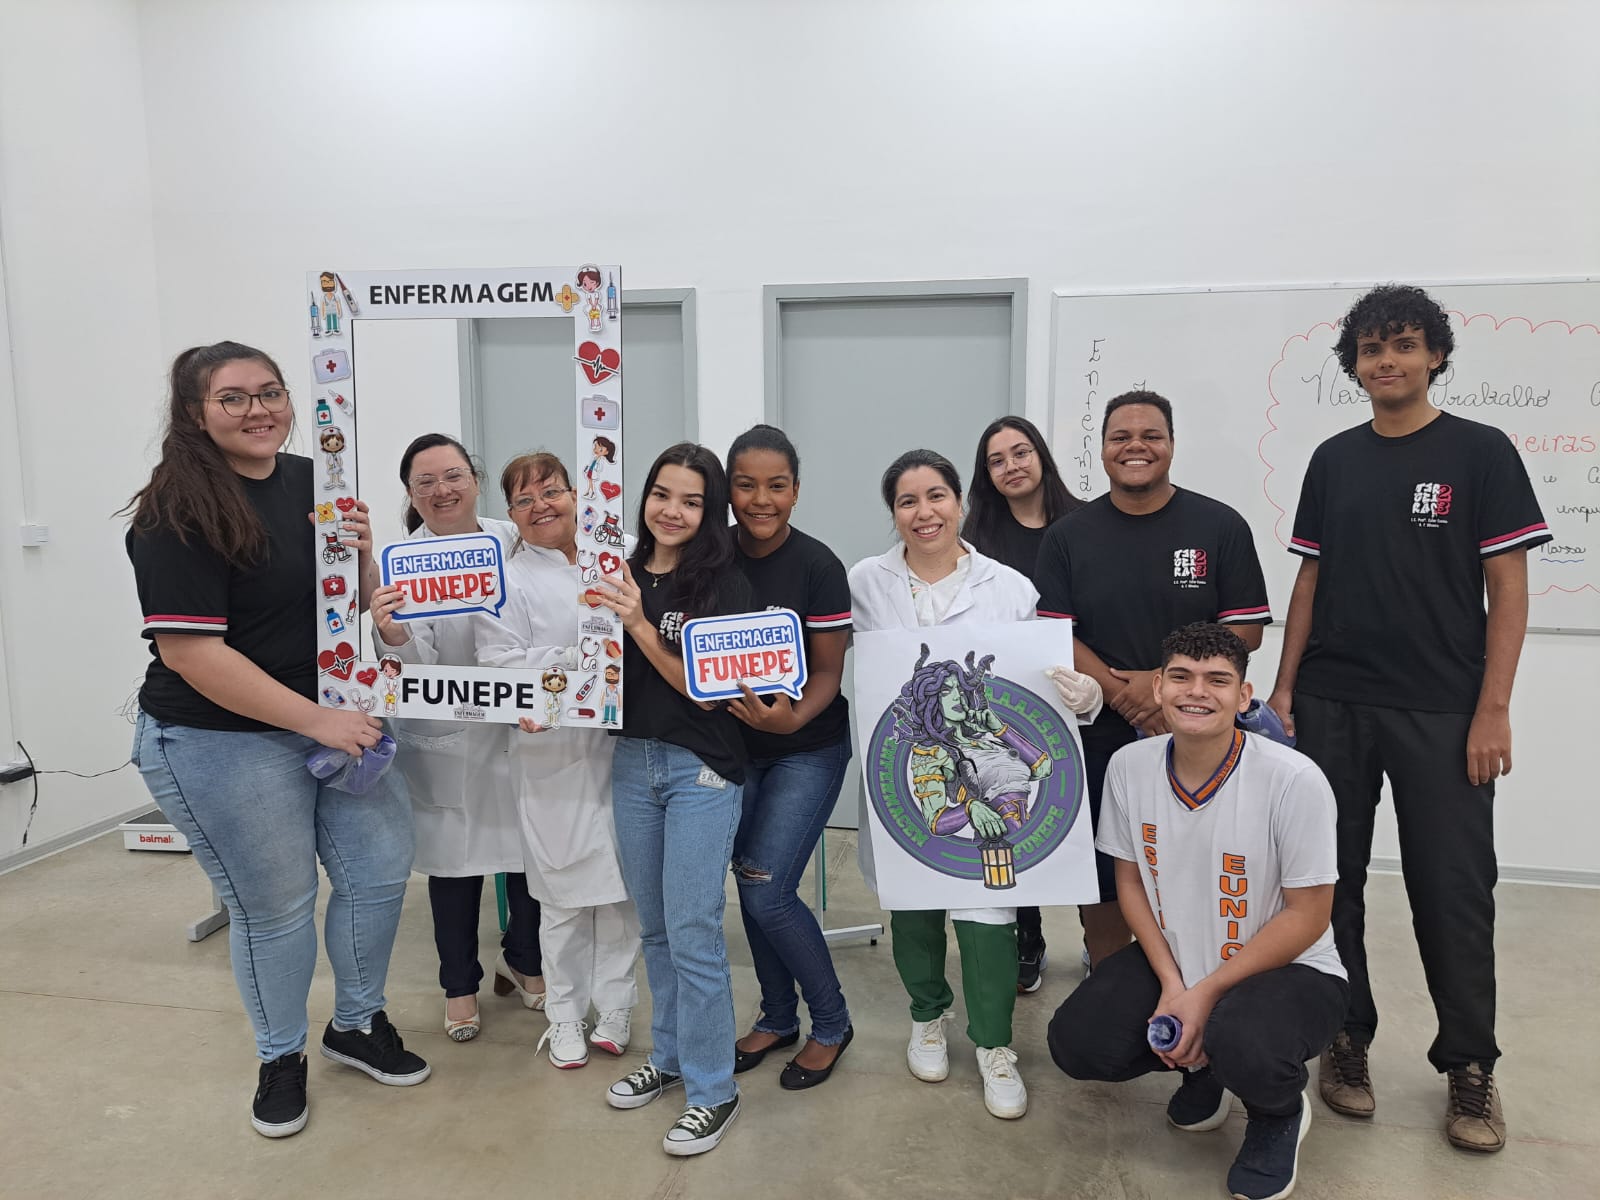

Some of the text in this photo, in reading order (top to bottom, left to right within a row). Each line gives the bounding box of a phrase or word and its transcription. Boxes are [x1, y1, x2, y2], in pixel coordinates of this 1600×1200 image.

[370, 282, 554, 304] ENFERMAGEM
[1301, 353, 1372, 406] Nos
[1431, 361, 1550, 408] Trabalho
[1074, 338, 1106, 500] Enferma
[392, 548, 496, 575] ENFERMAGEM
[395, 572, 495, 603] FUNEPE
[694, 625, 793, 653] ENFERMAGEM
[697, 649, 793, 682] FUNEPE
[402, 678, 534, 709] FUNEPE
[879, 736, 929, 848] ENFERMAGEM
[1013, 804, 1065, 860] FUNEPE
